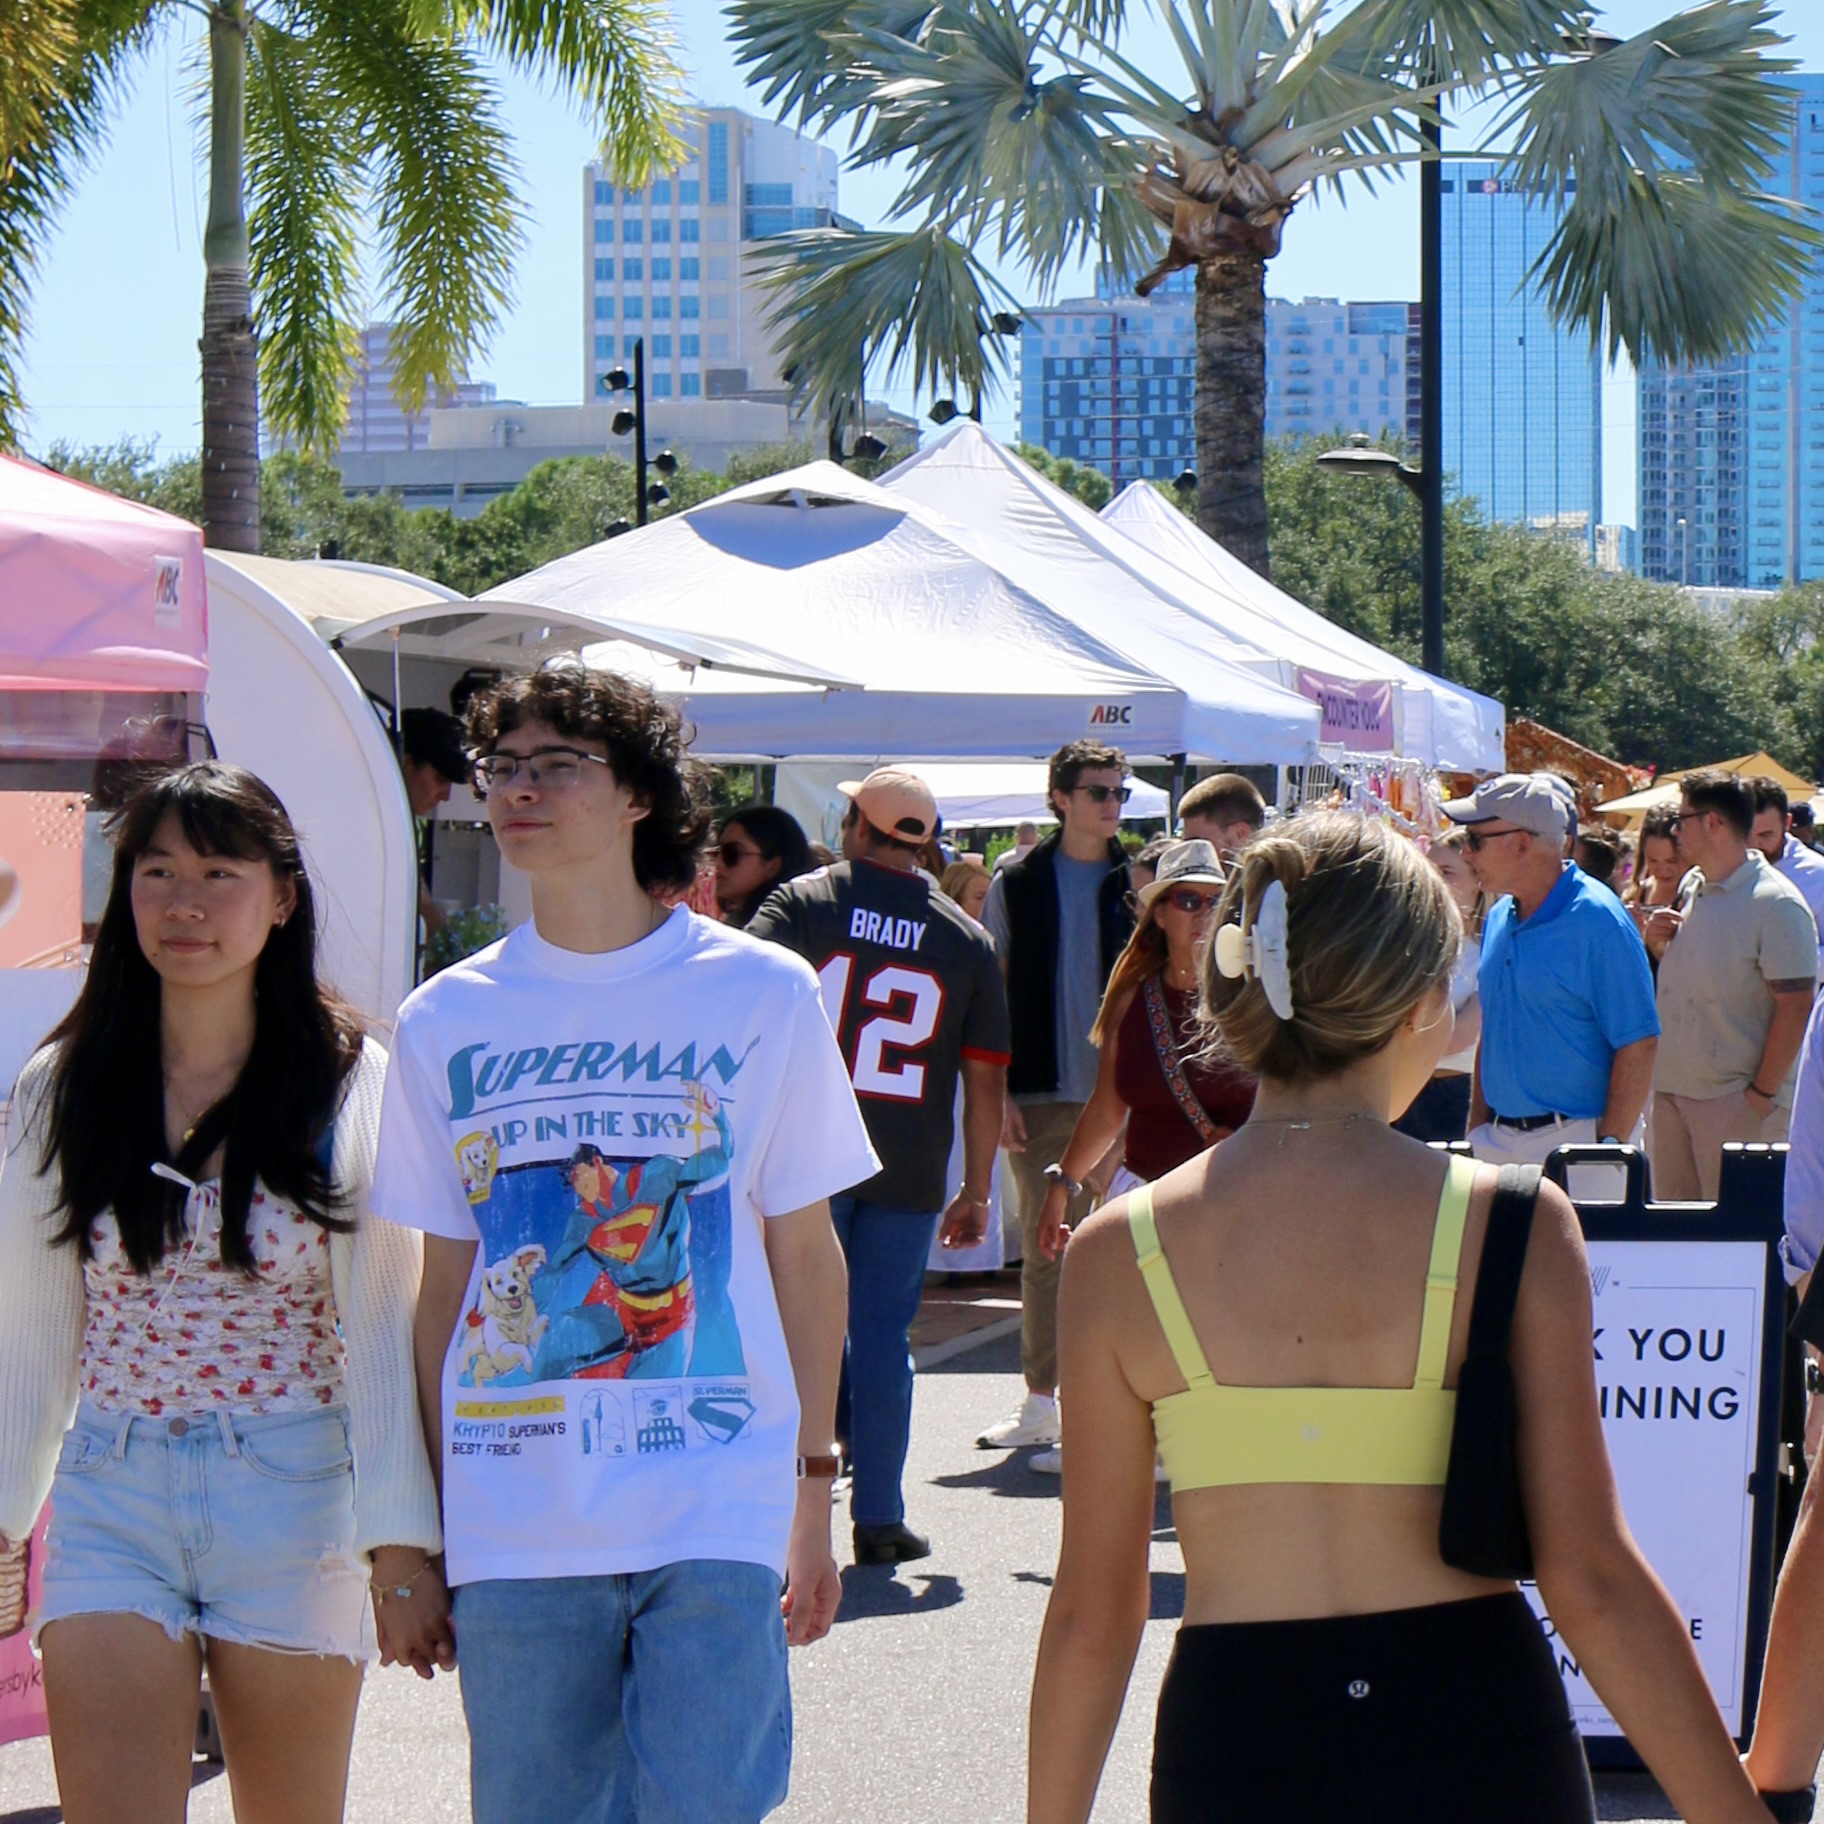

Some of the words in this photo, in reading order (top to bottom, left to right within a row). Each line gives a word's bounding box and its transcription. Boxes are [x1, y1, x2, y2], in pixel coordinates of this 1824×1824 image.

[1089, 704, 1133, 725] ABC
[850, 907, 927, 952] BRADY
[816, 951, 945, 1102] 12
[447, 1034, 761, 1121] SUPERMAN
[491, 1120, 528, 1149] UP
[535, 1113, 568, 1143] IN
[573, 1110, 624, 1138] THE
[631, 1111, 693, 1139] SKY
[1627, 1328, 1726, 1362] YOU
[1600, 1386, 1740, 1421] INING
[451, 1441, 484, 1456] BEST
